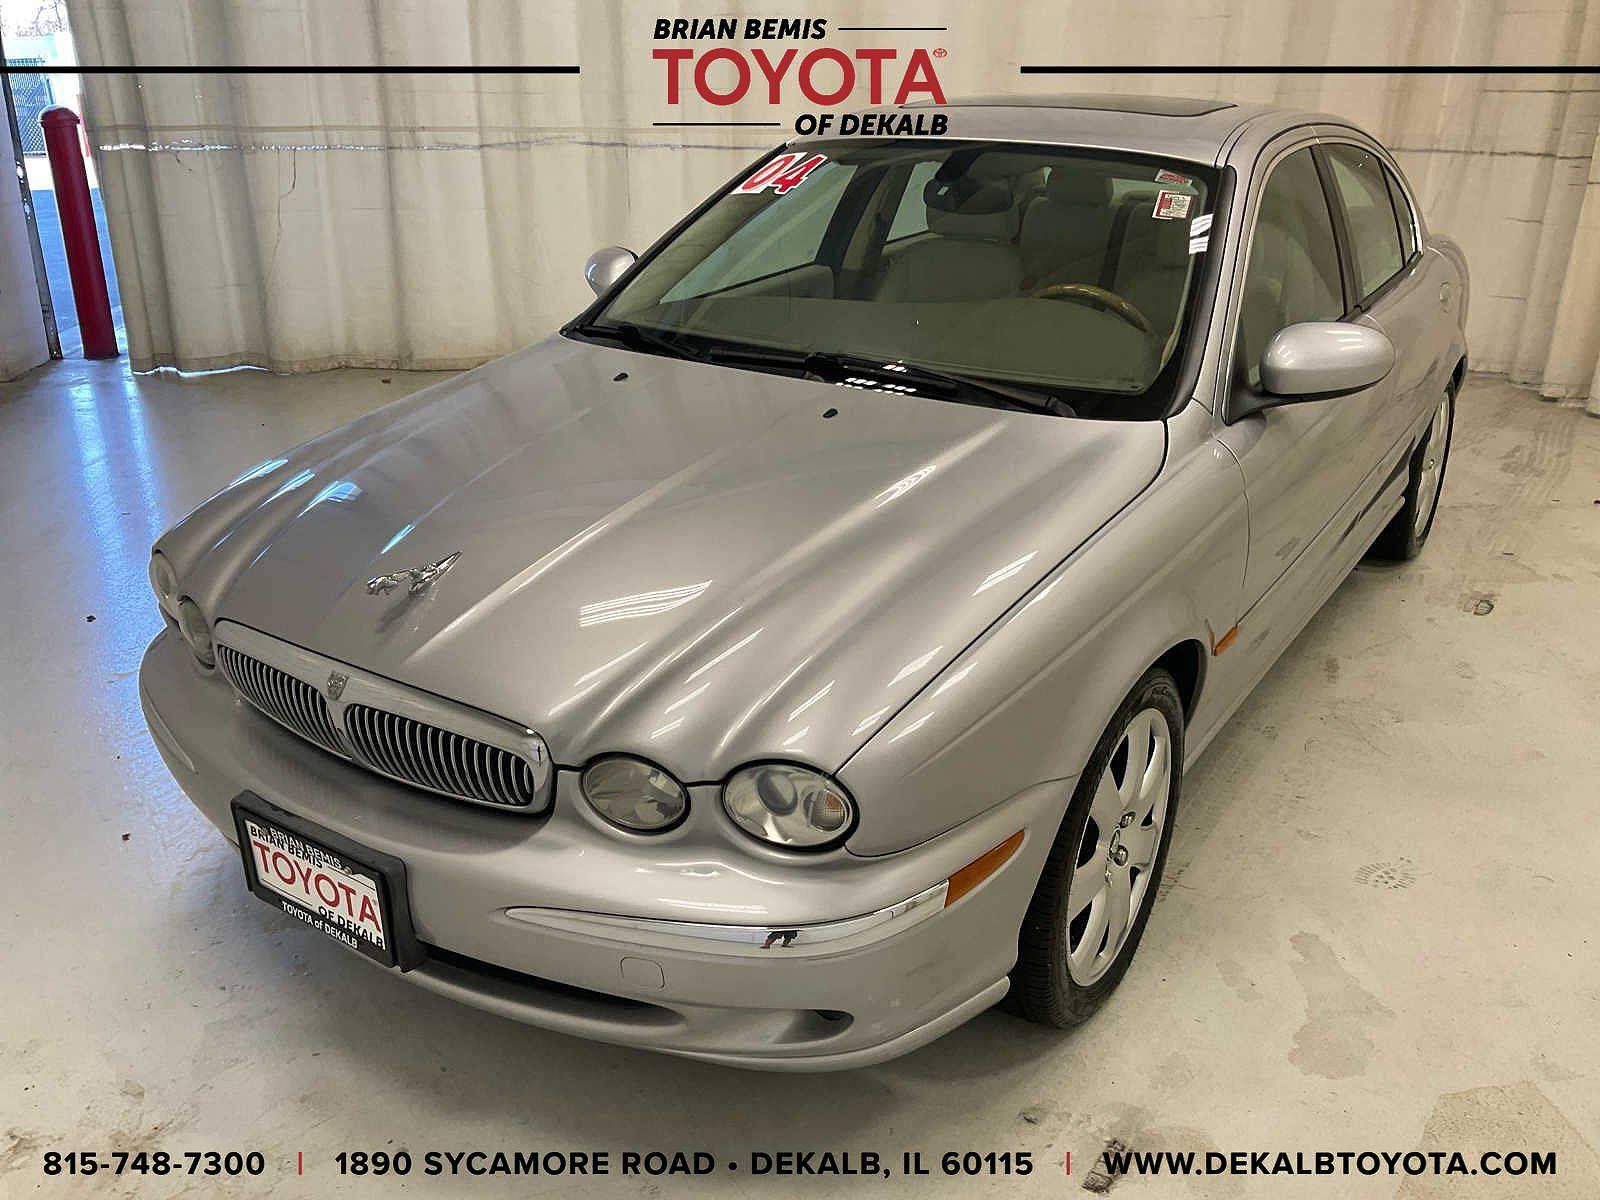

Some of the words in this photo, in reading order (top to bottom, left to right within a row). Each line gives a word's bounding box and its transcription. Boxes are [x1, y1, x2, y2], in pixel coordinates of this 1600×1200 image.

[269, 827, 304, 851] BRIAN
[304, 844, 343, 870] BEMIS
[252, 839, 382, 933] TOYOTA
[281, 900, 314, 926] TOYOTA
[324, 923, 359, 950] DEKALB
[318, 905, 335, 921] OF
[337, 914, 385, 949] DEKALB
